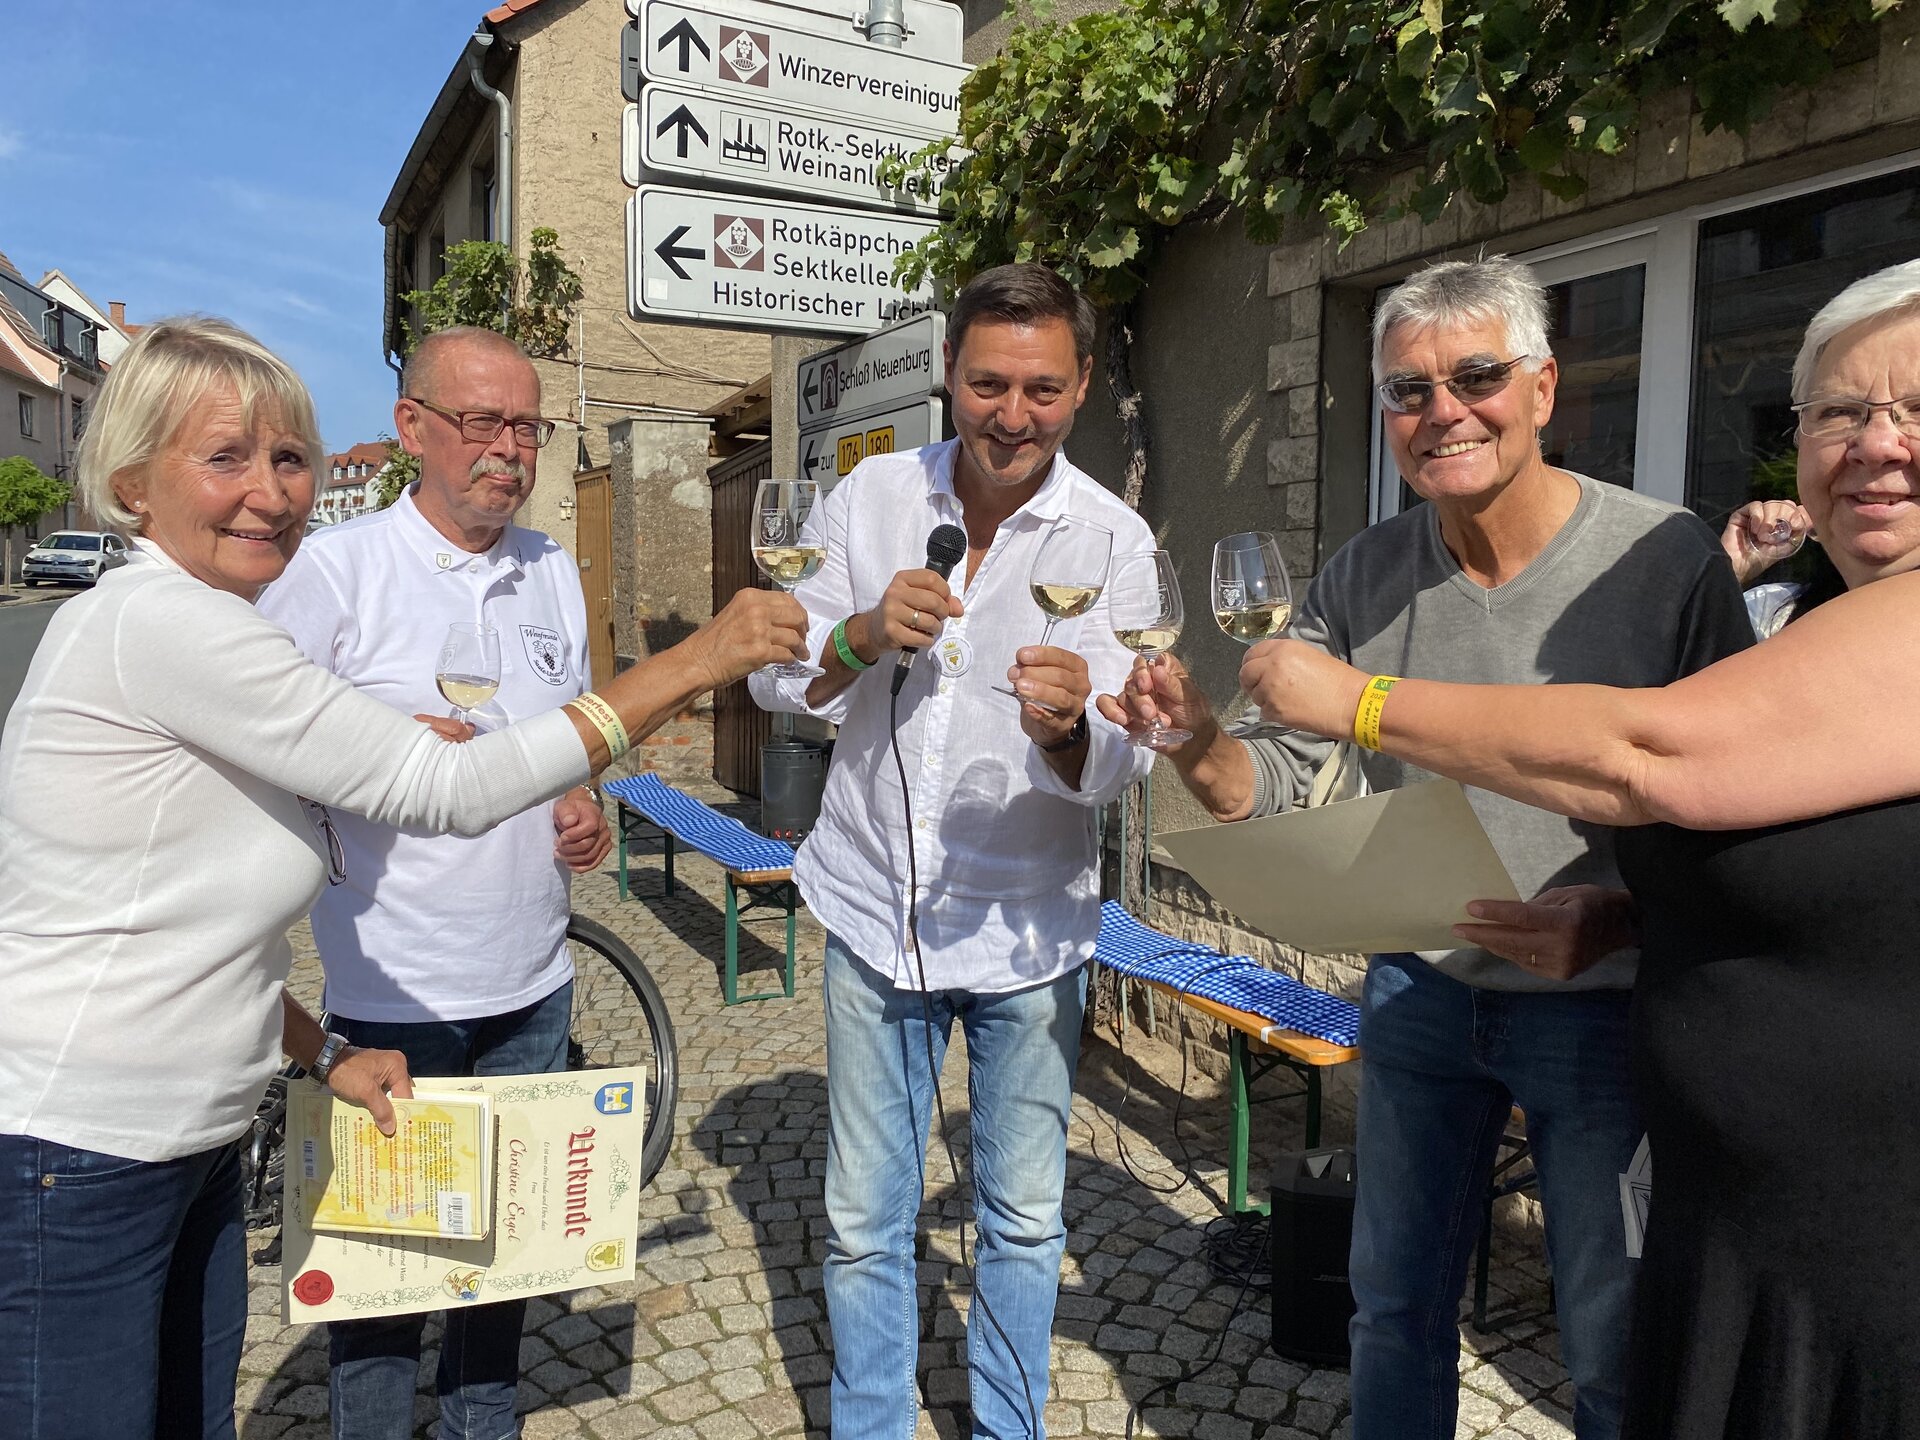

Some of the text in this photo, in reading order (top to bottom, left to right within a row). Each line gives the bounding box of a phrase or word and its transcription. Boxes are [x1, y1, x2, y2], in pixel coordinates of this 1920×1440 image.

[713, 281, 866, 318] Historischer
[839, 348, 930, 392] Schloß Neuenburg
[820, 434, 890, 471] zur 176 180
[503, 1138, 528, 1242] Christine Engel
[565, 1125, 597, 1239] Urkunde
